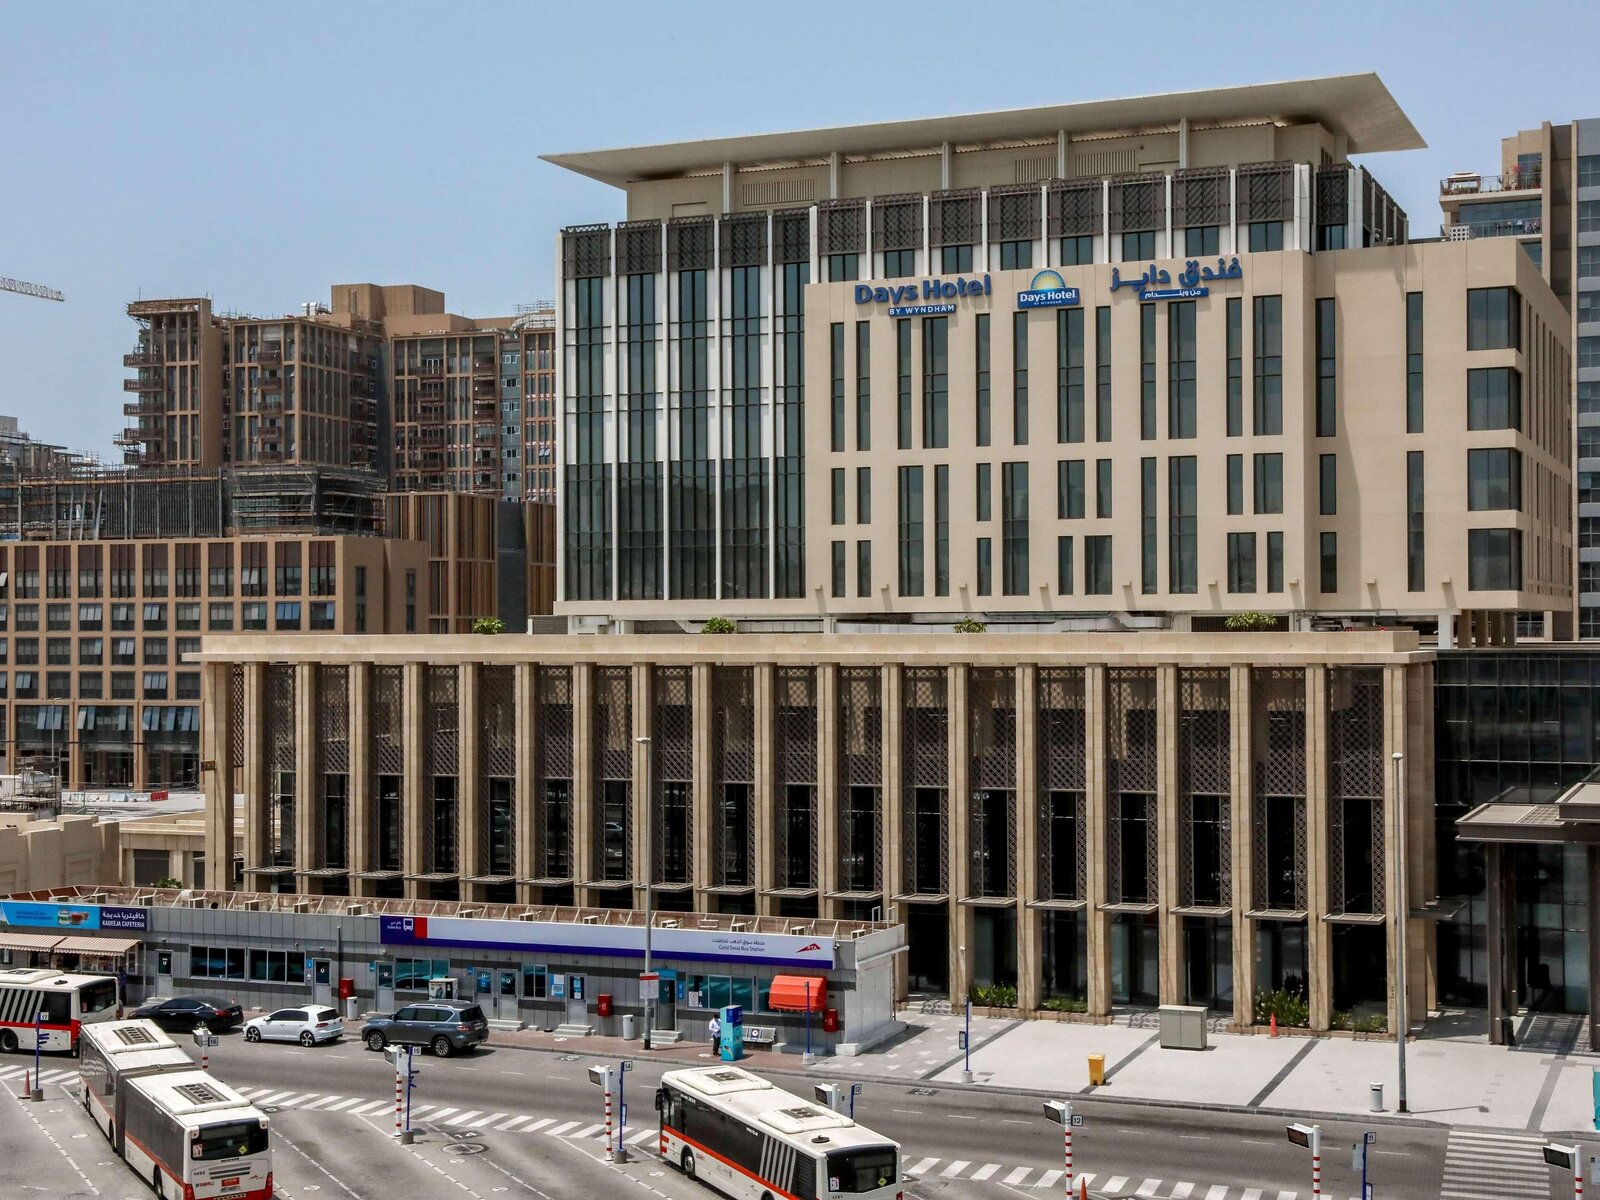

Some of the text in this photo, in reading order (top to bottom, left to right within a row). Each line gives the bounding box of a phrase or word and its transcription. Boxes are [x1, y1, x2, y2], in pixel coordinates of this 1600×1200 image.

[1178, 257, 1242, 287] فندق
[855, 274, 991, 305] Days Hotel
[1020, 289, 1076, 302] Days Hotel
[1189, 288, 1201, 296] من
[905, 305, 955, 314] WYNDHAM
